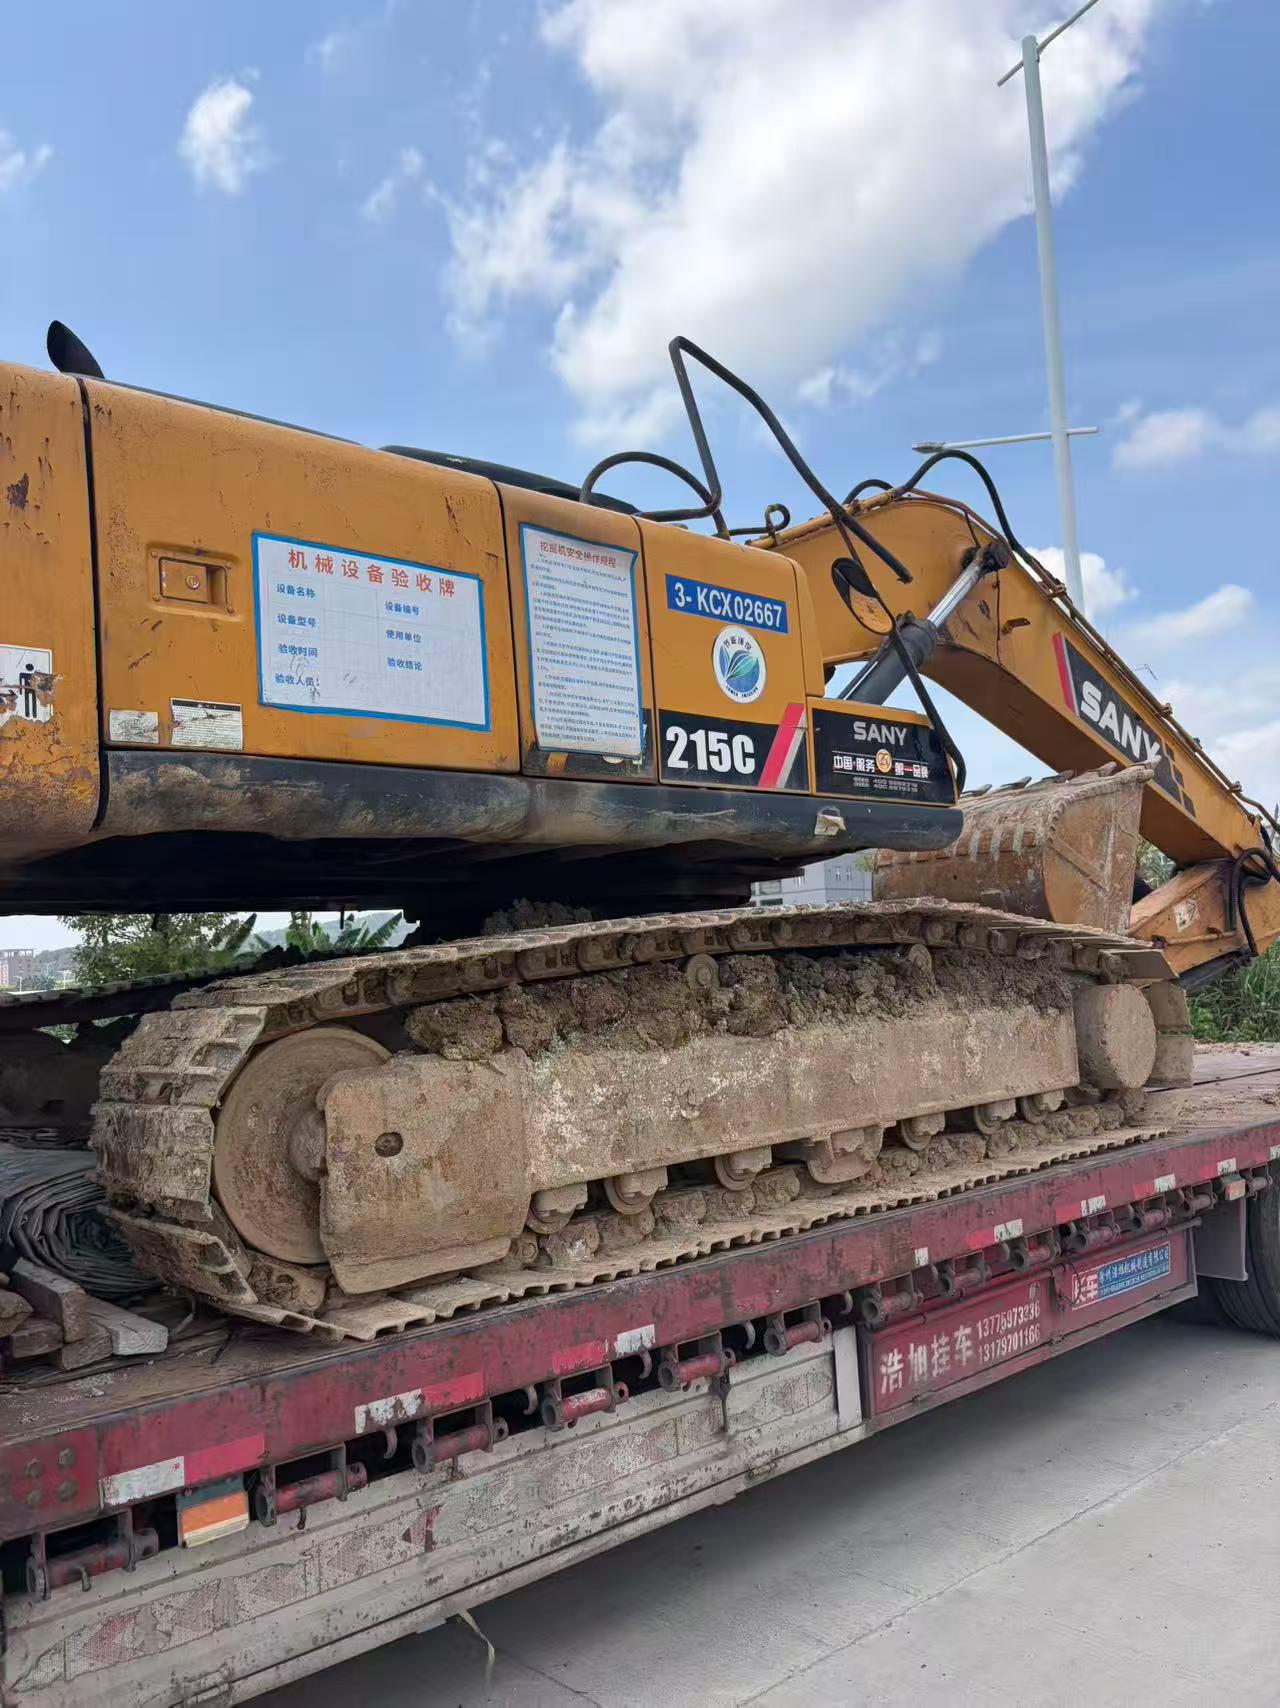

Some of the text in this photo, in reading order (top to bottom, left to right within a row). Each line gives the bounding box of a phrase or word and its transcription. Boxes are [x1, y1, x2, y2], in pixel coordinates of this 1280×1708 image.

[288, 548, 456, 598] 机械设备验收牌
[276, 583, 316, 599] 设备名称
[384, 600, 420, 616] 设备编号
[277, 613, 316, 628] 设备型号
[386, 629, 422, 643] 使用单位
[278, 643, 318, 657] 验收时间
[387, 657, 423, 672] 验收结论
[1081, 680, 1162, 762] SANY
[853, 721, 907, 746] SANY
[666, 725, 755, 775] 215C
